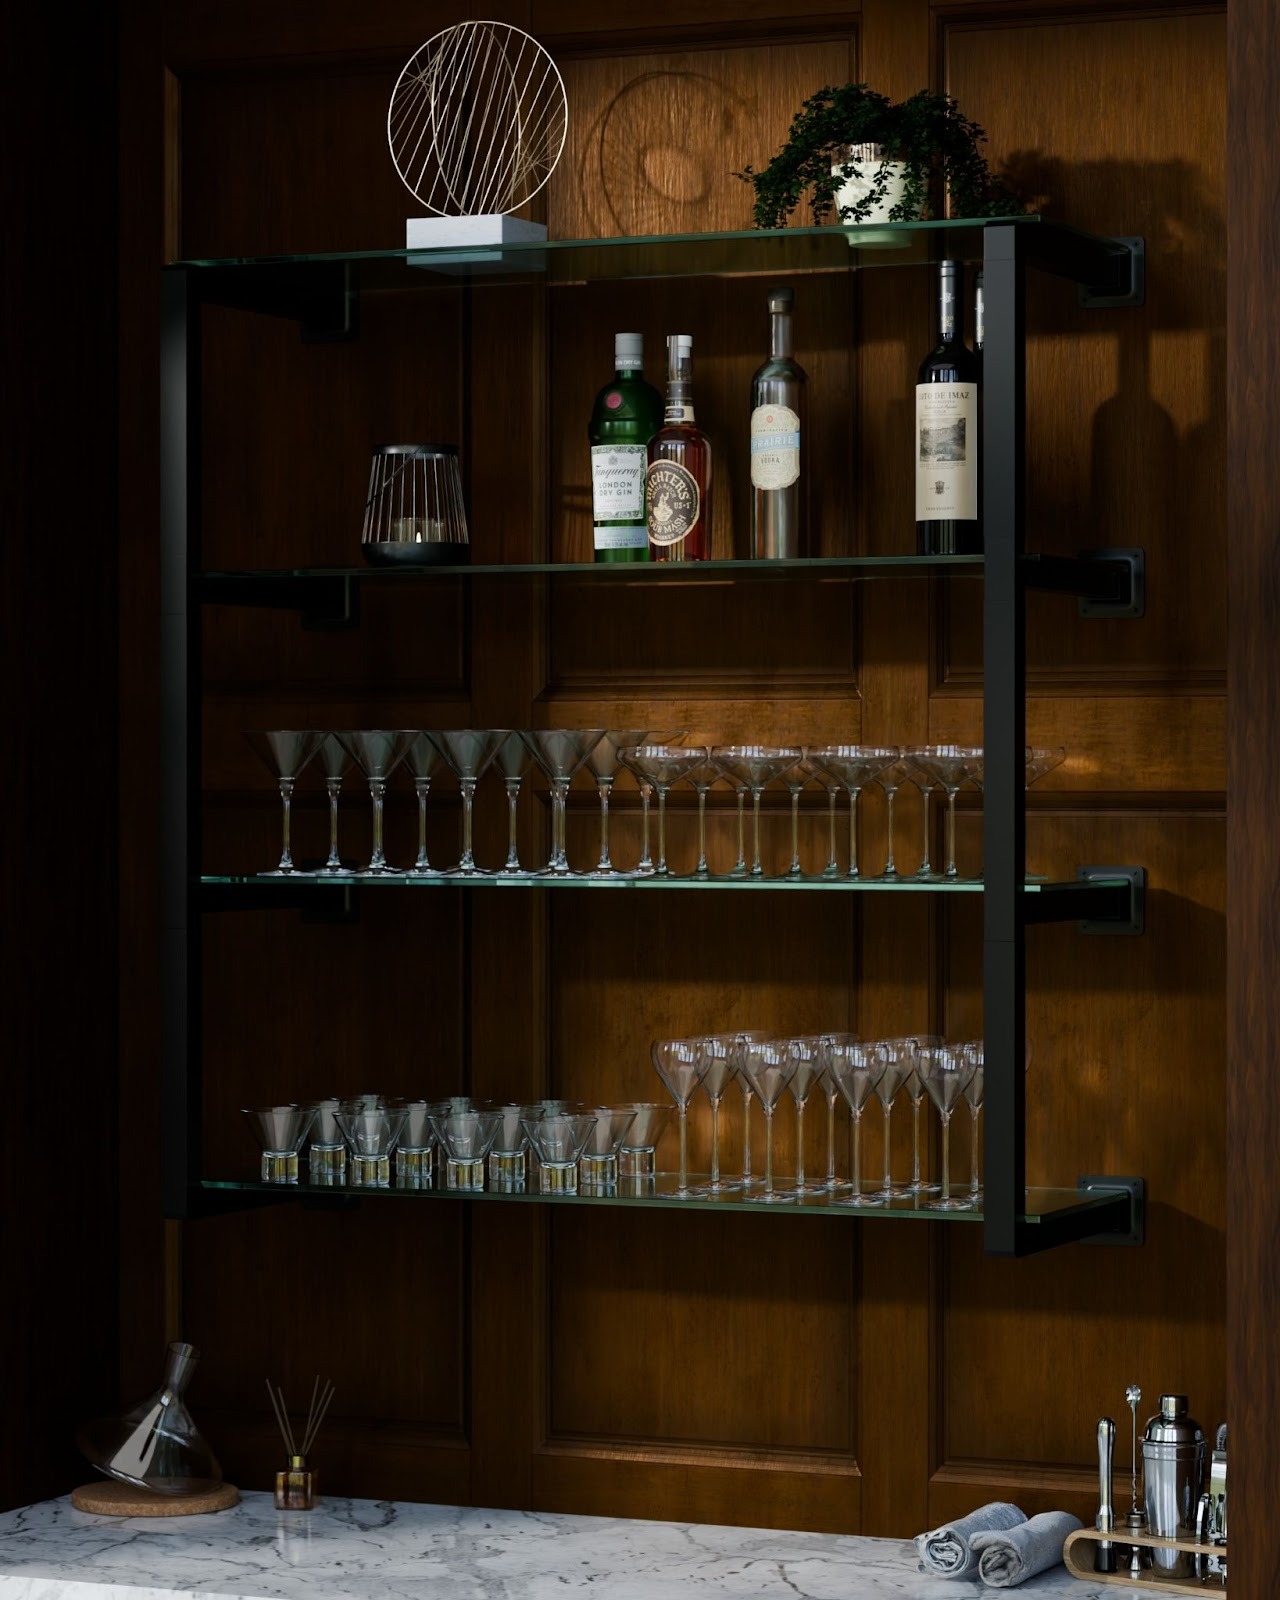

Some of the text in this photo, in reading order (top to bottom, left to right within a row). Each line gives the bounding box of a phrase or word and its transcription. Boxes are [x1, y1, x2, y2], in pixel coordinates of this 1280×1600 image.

[935, 391, 946, 400] DE
[948, 391, 970, 400] IMAZ
[752, 435, 794, 450] PRAIRIE
[599, 481, 632, 489] LONDON
[663, 513, 686, 534] MASH
